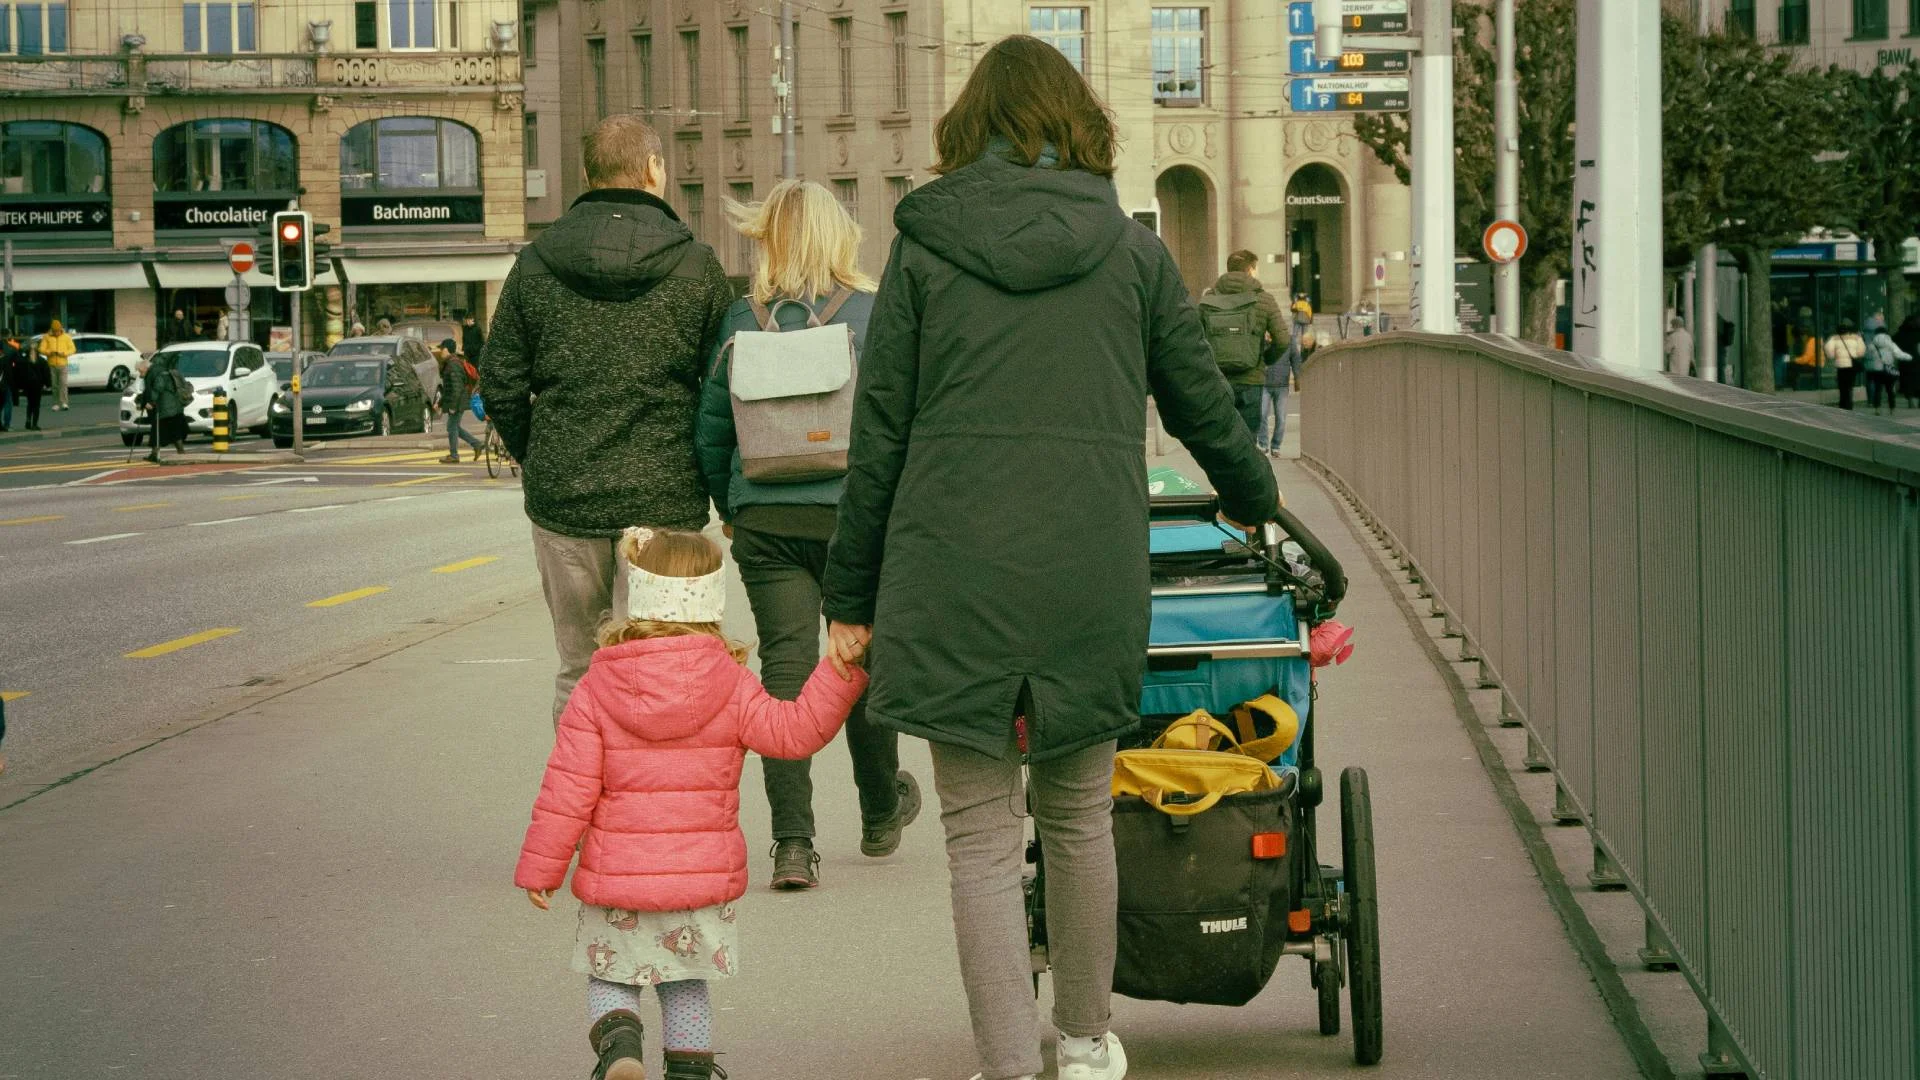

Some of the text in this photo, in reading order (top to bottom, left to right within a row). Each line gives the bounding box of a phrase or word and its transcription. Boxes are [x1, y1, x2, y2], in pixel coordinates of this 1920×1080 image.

[1342, 4, 1373, 12] IZERHOF
[1353, 15, 1361, 27] 0
[1343, 53, 1364, 67] 103
[1317, 82, 1369, 90] NATIONALHOF
[1348, 92, 1363, 105] 64
[5, 210, 84, 225] TEK PHILIPPE
[185, 206, 268, 224] Chocolatier
[373, 202, 451, 220] Bachmann
[1200, 917, 1248, 934] THULE
